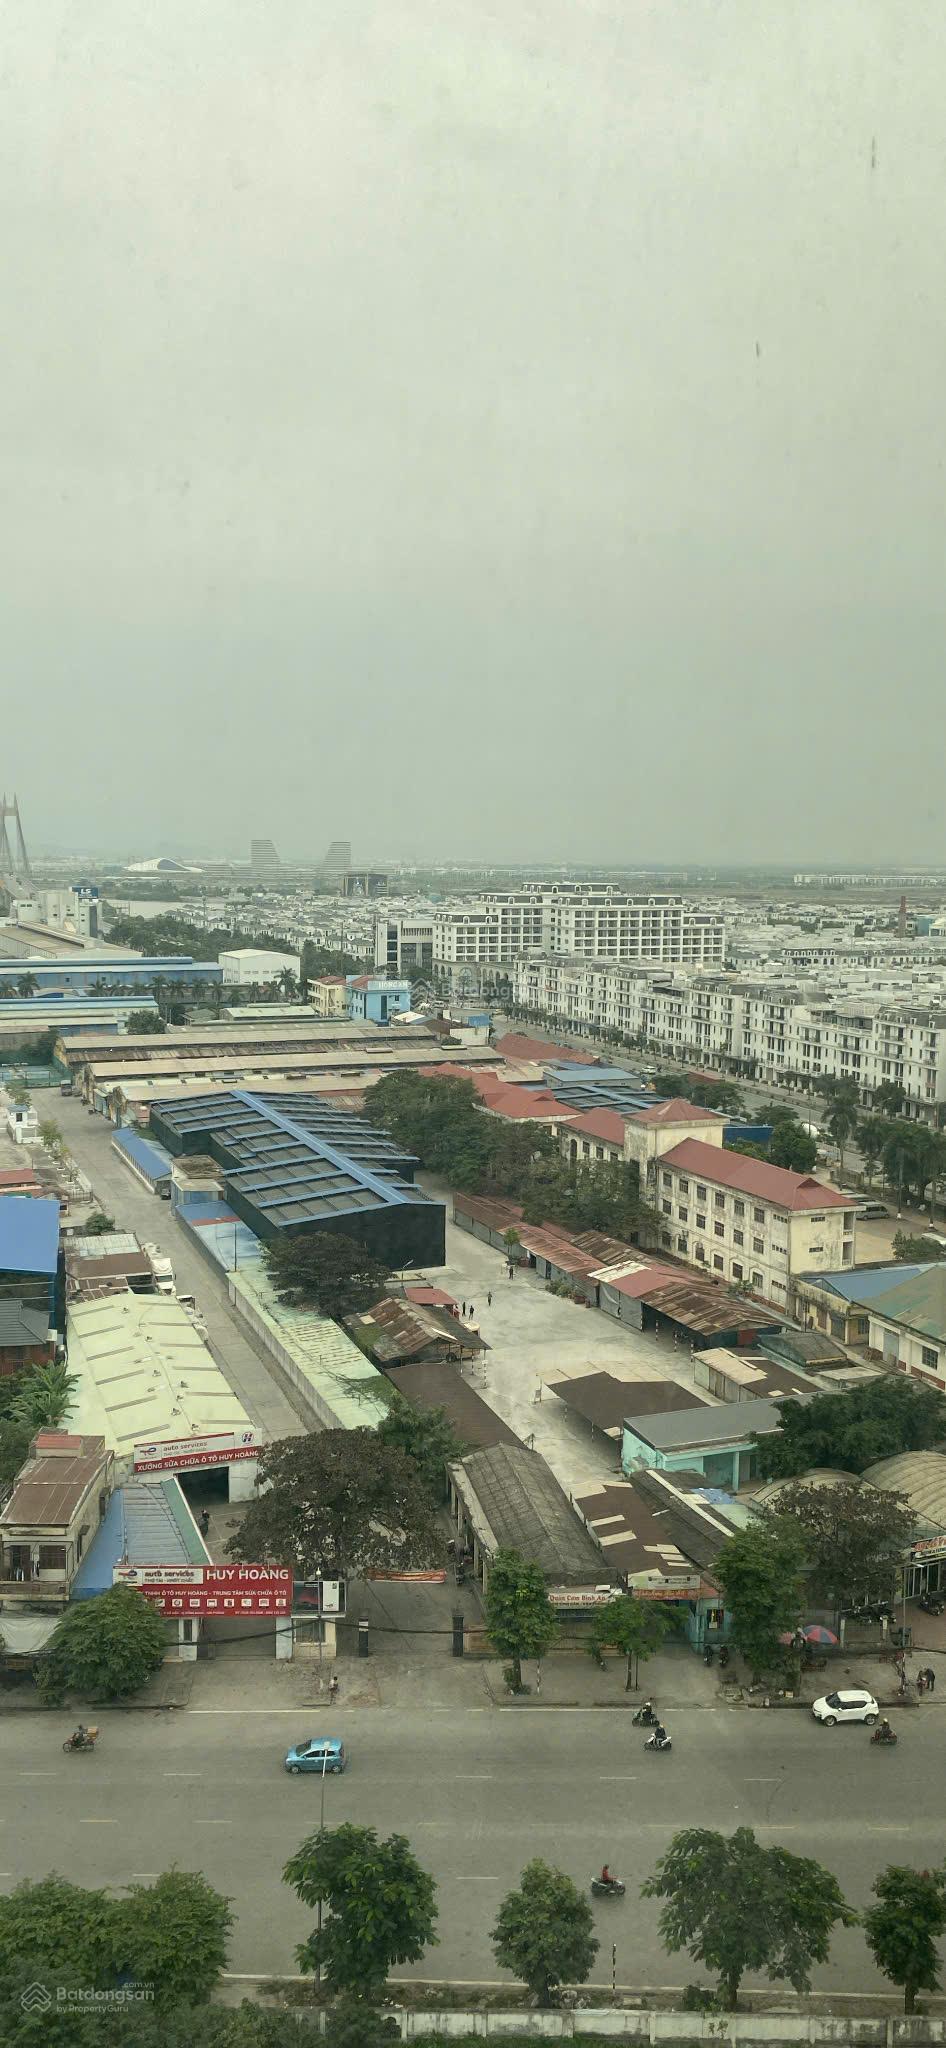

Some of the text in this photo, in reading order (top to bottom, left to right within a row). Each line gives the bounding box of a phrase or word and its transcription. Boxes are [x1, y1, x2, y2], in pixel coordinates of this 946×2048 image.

[180, 1441, 208, 1449] services
[201, 1454, 207, 1463] Ô
[208, 1454, 217, 1462] TÔ
[234, 1449, 259, 1459] HOÀNG
[206, 1566, 289, 1580] HUY HOÀNG
